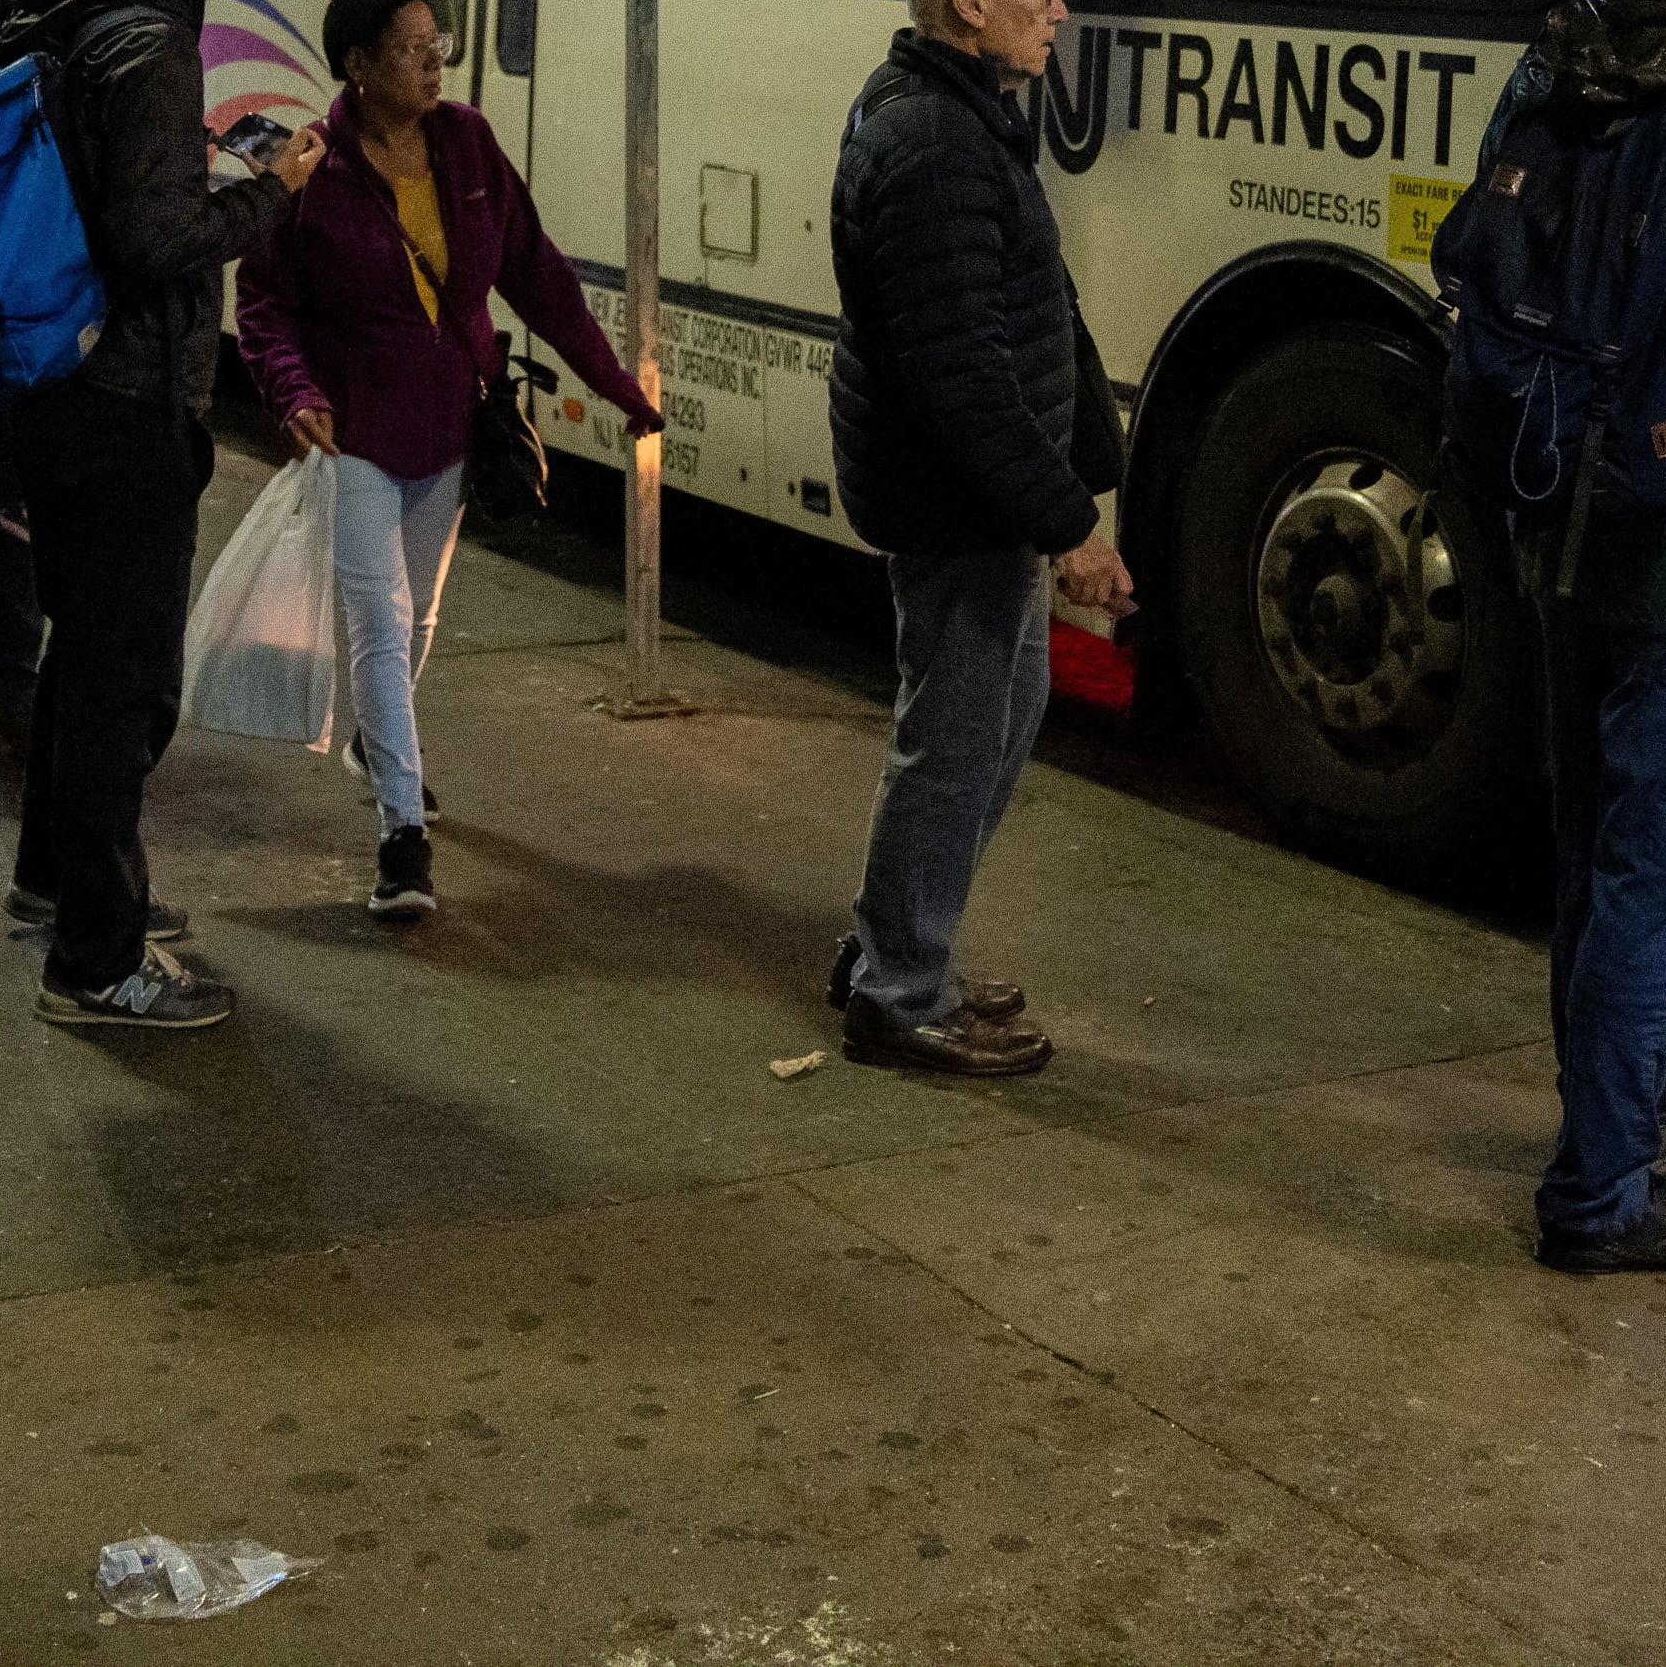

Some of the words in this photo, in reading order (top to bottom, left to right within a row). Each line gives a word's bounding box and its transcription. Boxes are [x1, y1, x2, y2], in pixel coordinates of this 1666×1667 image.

[1115, 30, 1476, 167] TRANSIT
[1228, 179, 1382, 229] STANDEES:15
[1395, 181, 1423, 198] EXACT
[1426, 185, 1450, 202] FARE
[691, 312, 761, 363] CORPORATION
[678, 347, 738, 395] OPERATIONS
